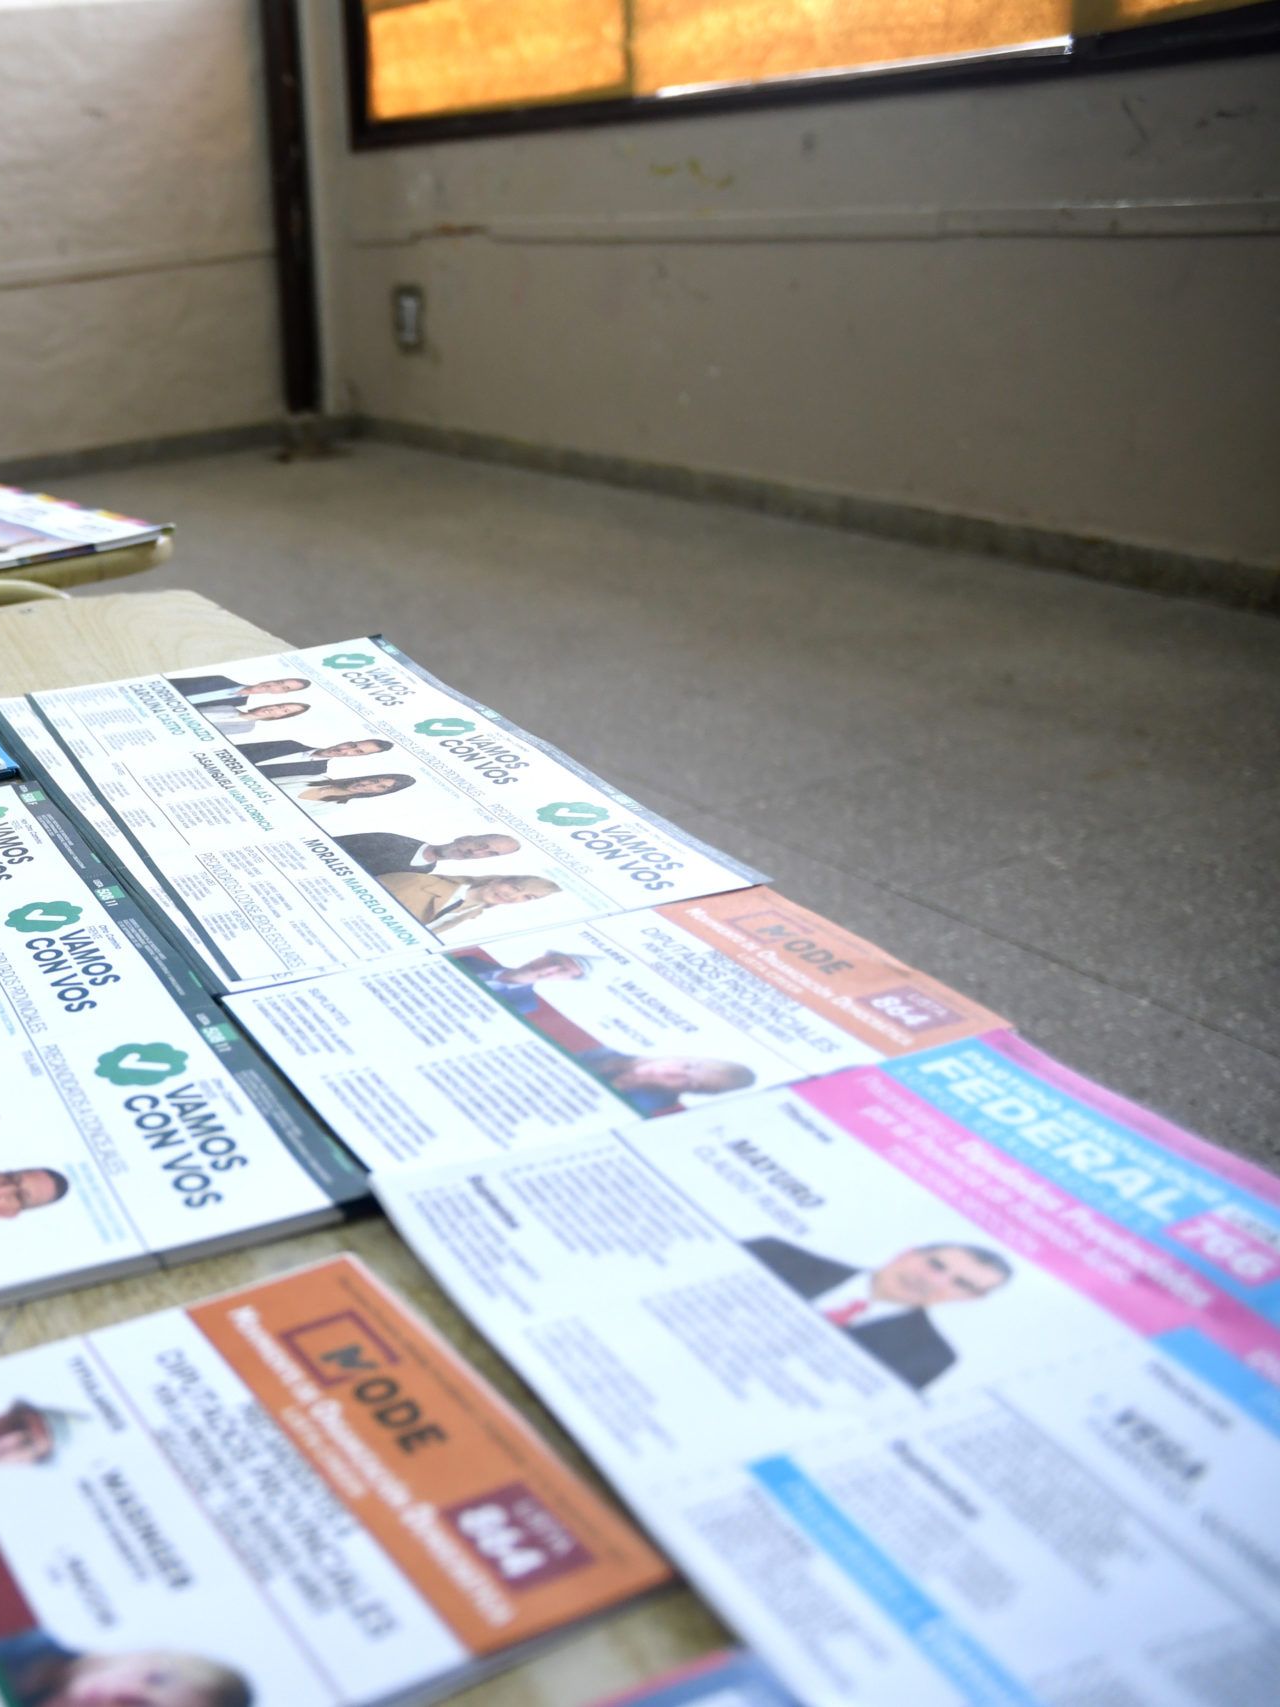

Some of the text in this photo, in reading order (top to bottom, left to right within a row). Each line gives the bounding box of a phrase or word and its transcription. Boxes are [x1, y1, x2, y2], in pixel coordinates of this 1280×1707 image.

[127, 683, 168, 713] CAROLINA
[155, 713, 188, 736] CASTRO
[338, 670, 405, 707] CON VOS
[362, 667, 417, 696] VAMOS
[211, 748, 249, 775] TERRERA
[236, 773, 272, 799] NICOLAS
[435, 738, 486, 762] CON
[468, 761, 521, 785] VOS
[462, 734, 531, 770] VAMOS
[191, 752, 237, 790] CASAMIQUELA
[239, 803, 276, 832] FLORENCIA
[565, 828, 678, 891] CON VOS
[597, 824, 686, 871] VAMOS
[94, 886, 115, 901] 508
[301, 838, 421, 946] MORALES MARCELO RAMON
[22, 936, 100, 1014] CON VOS
[55, 928, 124, 987] VAMOS
[617, 981, 701, 1033] WASINGER
[638, 927, 844, 1053] DIPUTADOS PROVINCIALES
[865, 995, 934, 1027] 864
[119, 1092, 227, 1210] CON VOS
[159, 1083, 252, 1173] VAMOS
[913, 1055, 1203, 1223] FEDERAL
[725, 1139, 830, 1209] MAYURO
[317, 1342, 455, 1457] MODE
